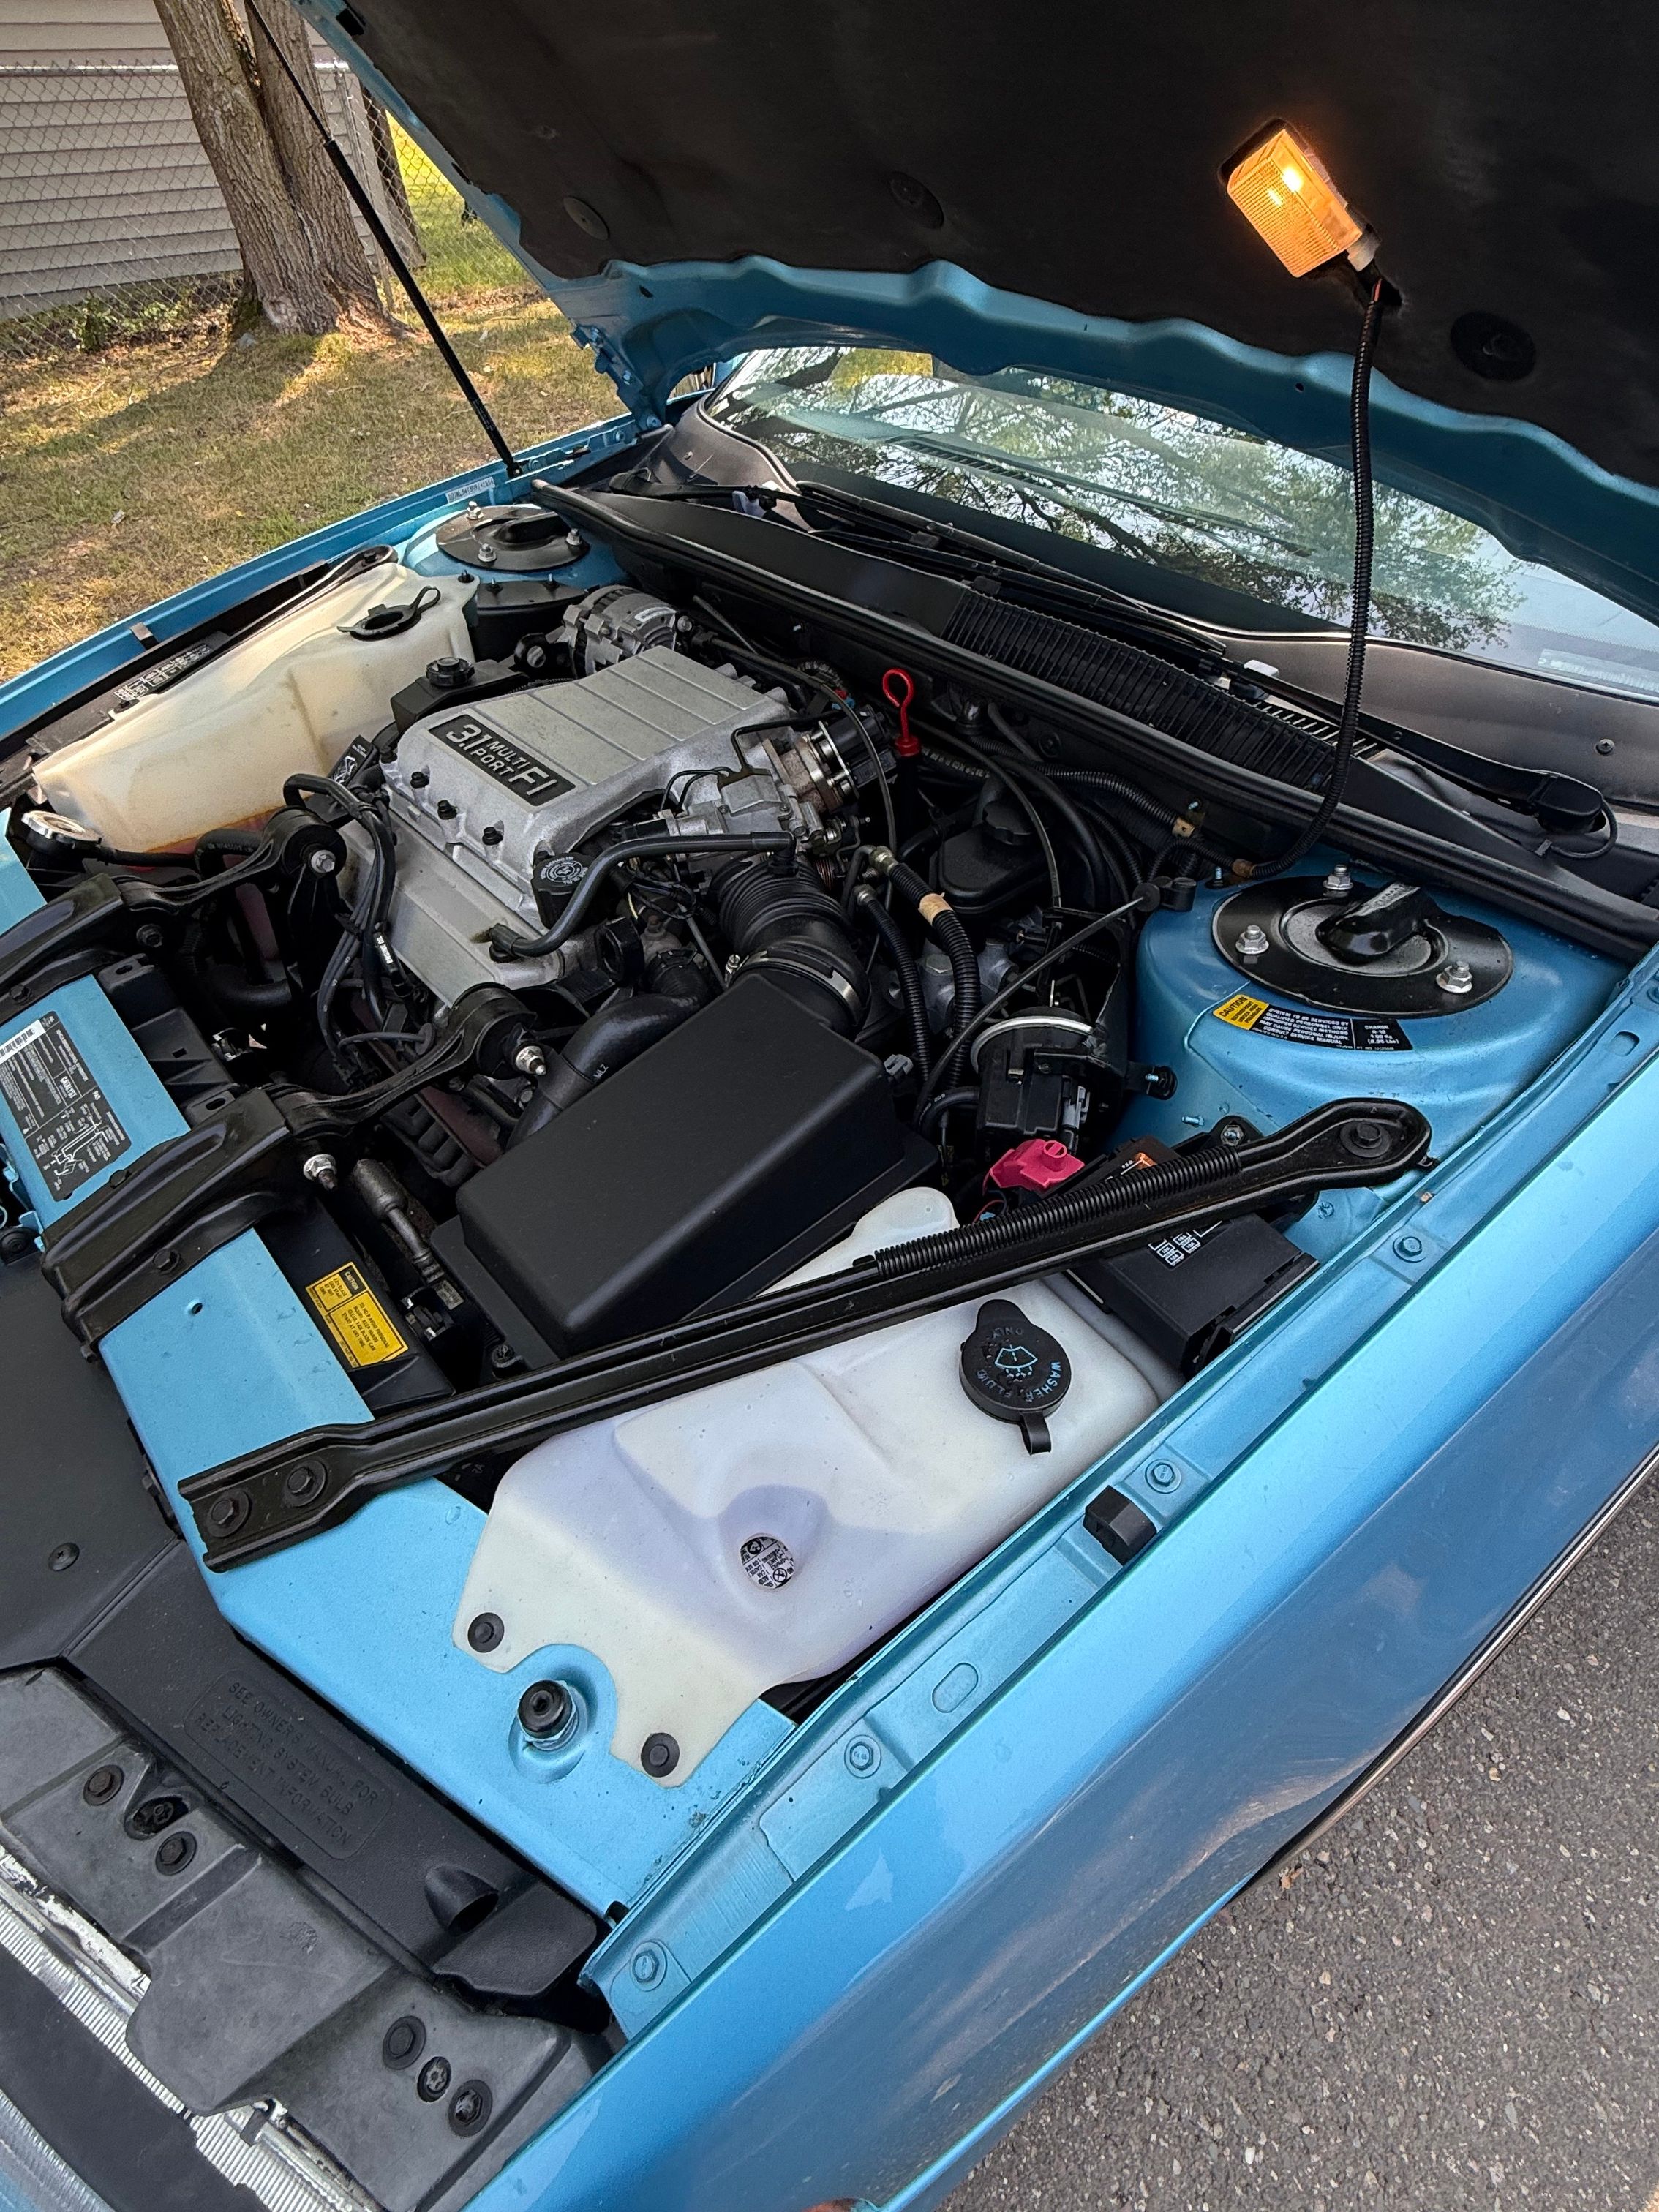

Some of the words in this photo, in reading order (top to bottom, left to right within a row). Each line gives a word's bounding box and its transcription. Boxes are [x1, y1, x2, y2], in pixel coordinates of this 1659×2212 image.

[446, 723, 492, 750] 3.1
[470, 748, 515, 776] PORT
[486, 741, 532, 770] MULTI
[508, 767, 557, 796] FI
[1219, 996, 1248, 1017] CAUTION
[1268, 1008, 1291, 1017] SYSTEM
[60, 1075, 78, 1099] CATALYST
[345, 1271, 360, 1290] CAUTION
[992, 1327, 1023, 1339] ONLY
[977, 1369, 1013, 1398] FLUID
[1026, 1361, 1062, 1402] WASHER
[228, 1682, 252, 1704] SEE
[353, 1779, 378, 1807] FOR
[274, 1748, 319, 1787] SYSTEM
[320, 1786, 353, 1814] BULB
